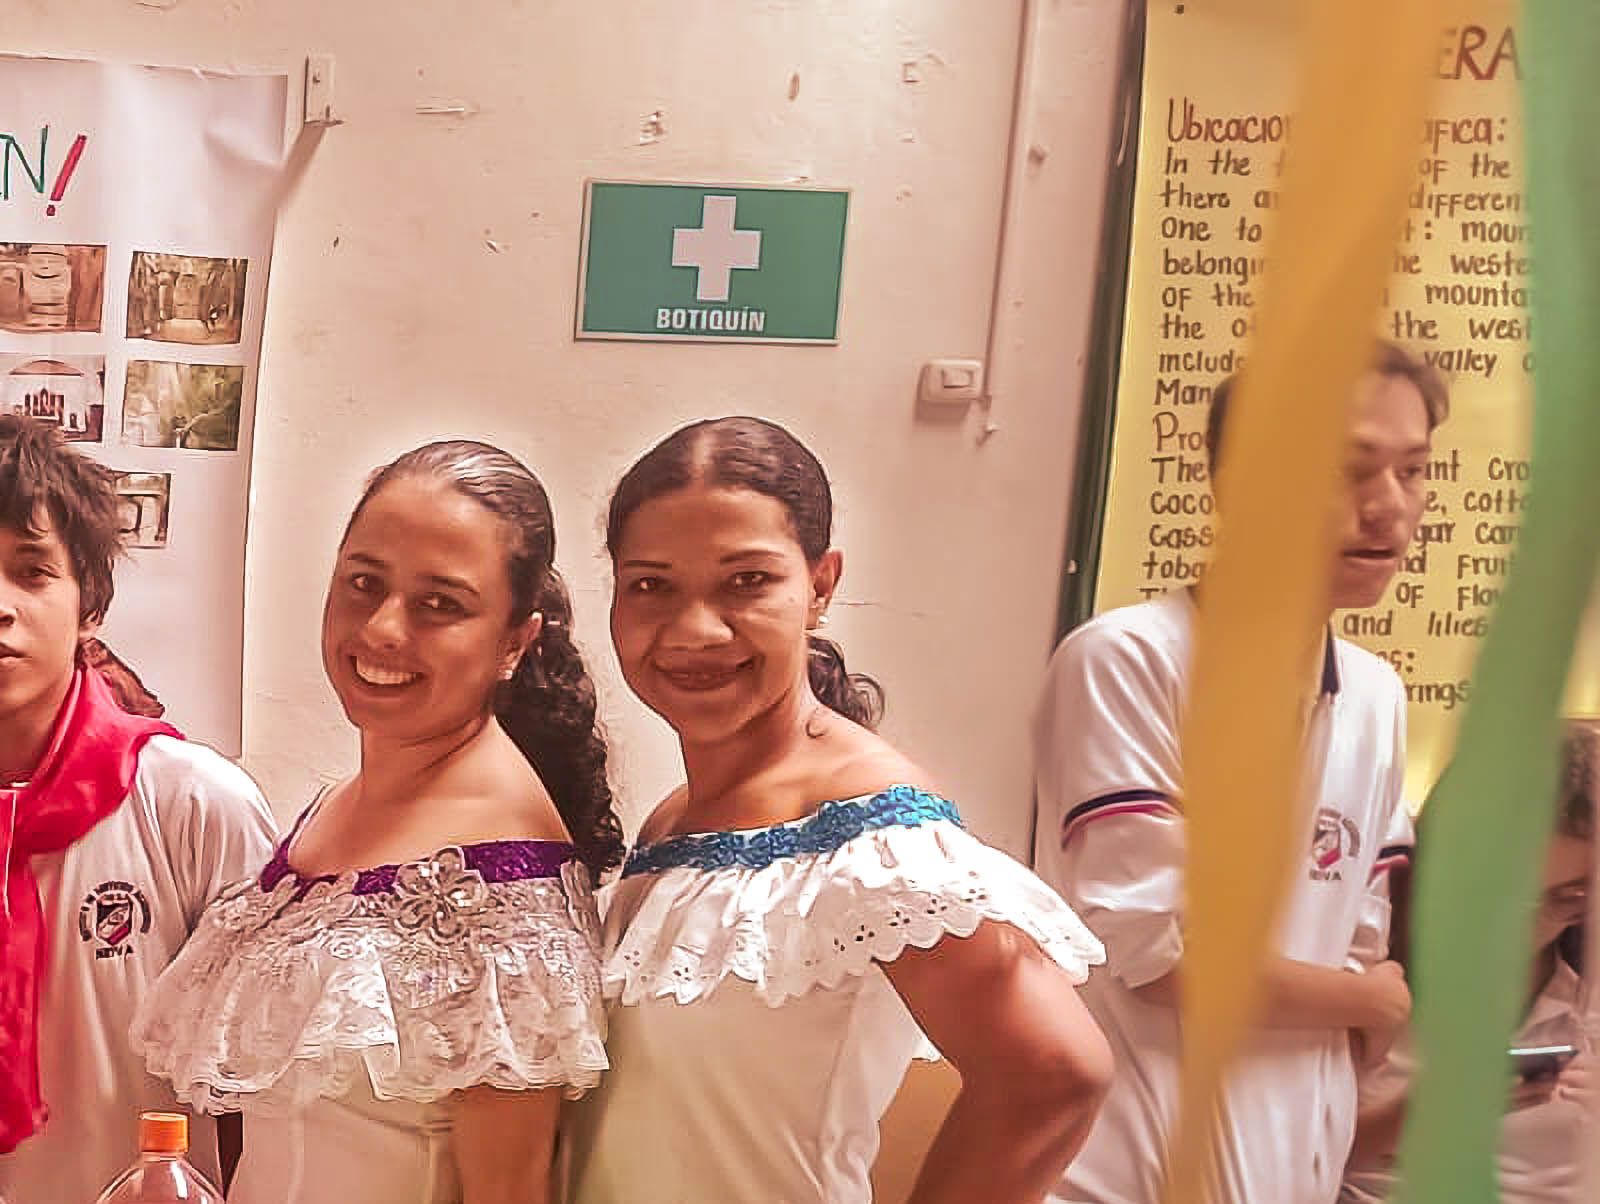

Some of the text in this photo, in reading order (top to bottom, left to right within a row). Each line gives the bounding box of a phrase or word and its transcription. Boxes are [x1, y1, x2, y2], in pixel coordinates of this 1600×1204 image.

[1208, 149, 1251, 176] the
[1472, 152, 1511, 178] the
[1236, 217, 1262, 242] to
[656, 306, 766, 332] BOTIQUÍN
[1160, 312, 1205, 339] the
[1391, 310, 1439, 340] the
[1425, 348, 1497, 377] valley
[1344, 610, 1392, 637] and
